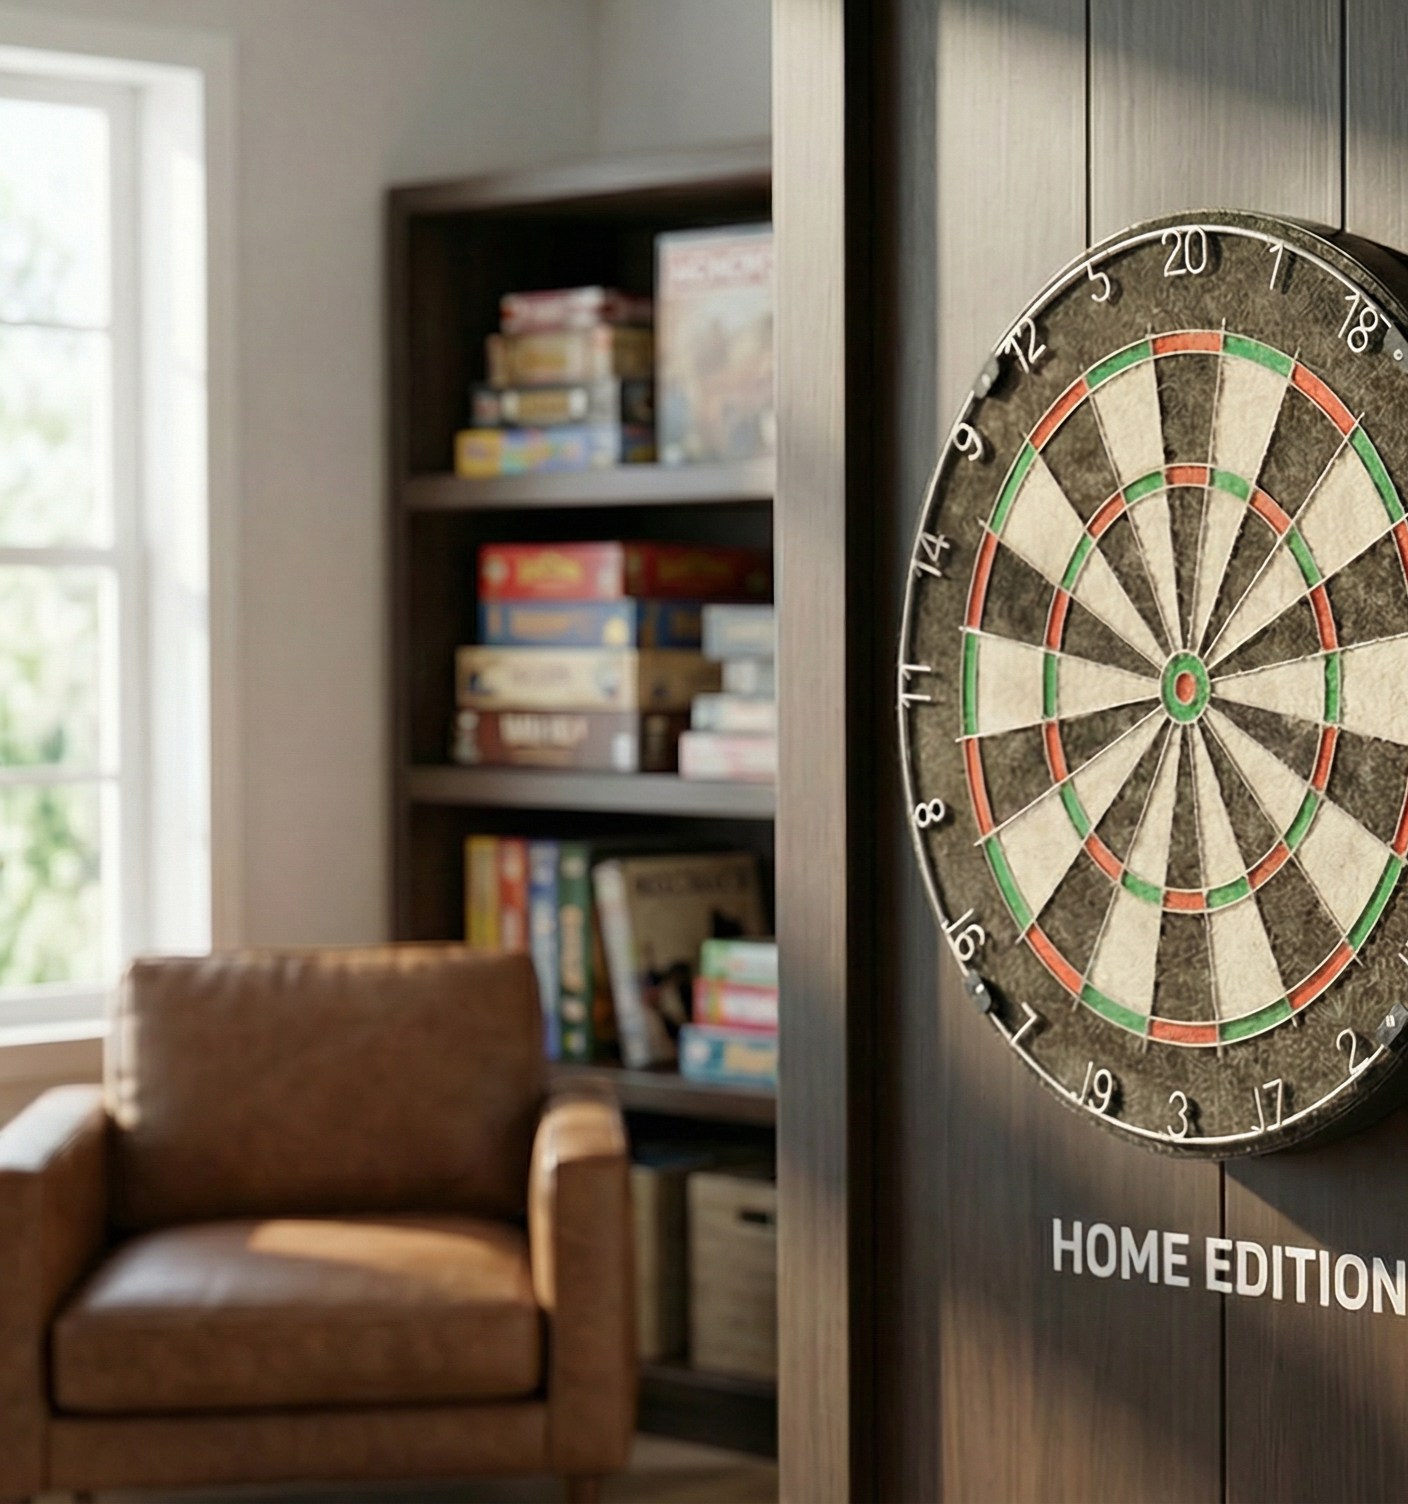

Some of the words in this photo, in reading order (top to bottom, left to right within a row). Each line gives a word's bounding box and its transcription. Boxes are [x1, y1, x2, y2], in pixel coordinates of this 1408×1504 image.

[1162, 225, 1208, 277] 20
[1269, 241, 1284, 290] 1
[1086, 262, 1111, 301] 5
[1004, 316, 1047, 373] 12
[1338, 290, 1379, 352] 18
[952, 421, 981, 462] 9
[914, 532, 950, 578] 14
[900, 660, 931, 708] 11
[914, 796, 946, 828] 8
[940, 908, 986, 962] 16
[1010, 1001, 1039, 1046] 7
[1336, 1028, 1373, 1076] 2
[1070, 1061, 1113, 1114] 19
[1250, 1079, 1284, 1132] 17
[1167, 1091, 1190, 1139] 3
[1052, 1217, 1190, 1288] HOME
[1205, 1236, 1407, 1317] EDITION
